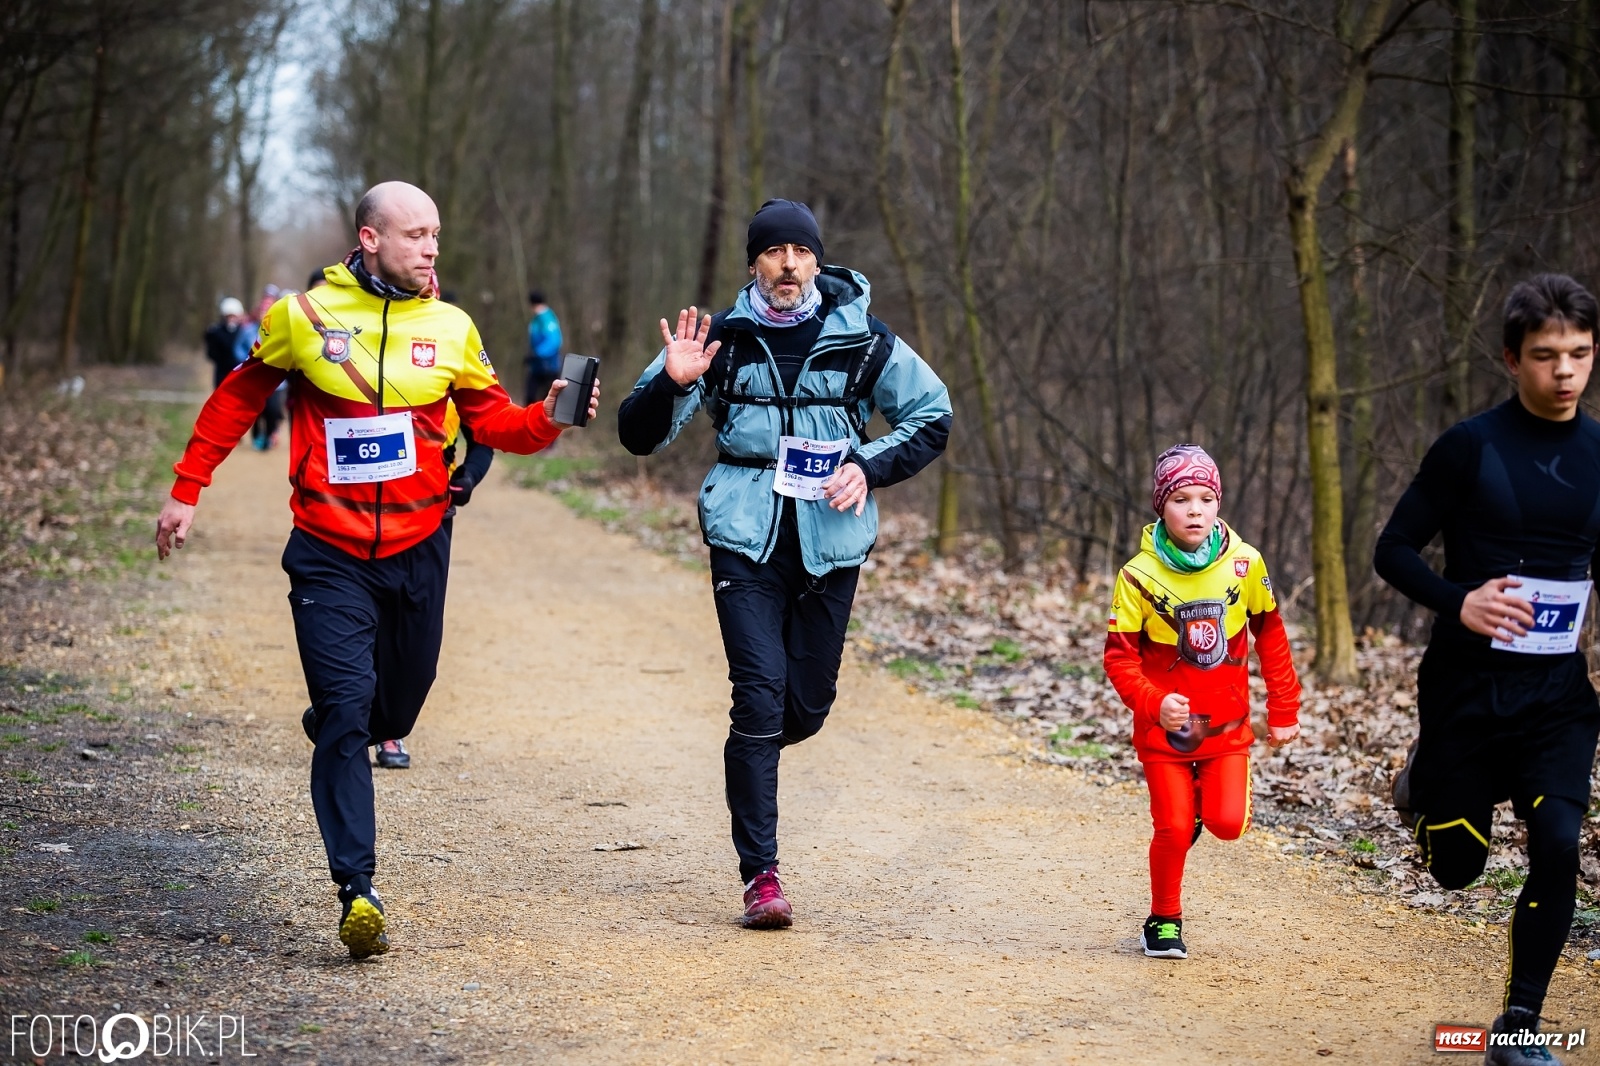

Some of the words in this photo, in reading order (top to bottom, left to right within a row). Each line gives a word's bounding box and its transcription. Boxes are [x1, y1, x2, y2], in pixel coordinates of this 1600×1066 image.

[358, 442, 381, 459] 69
[803, 457, 831, 474] 134
[1536, 610, 1561, 628] 47
[1197, 653, 1212, 664] OCR
